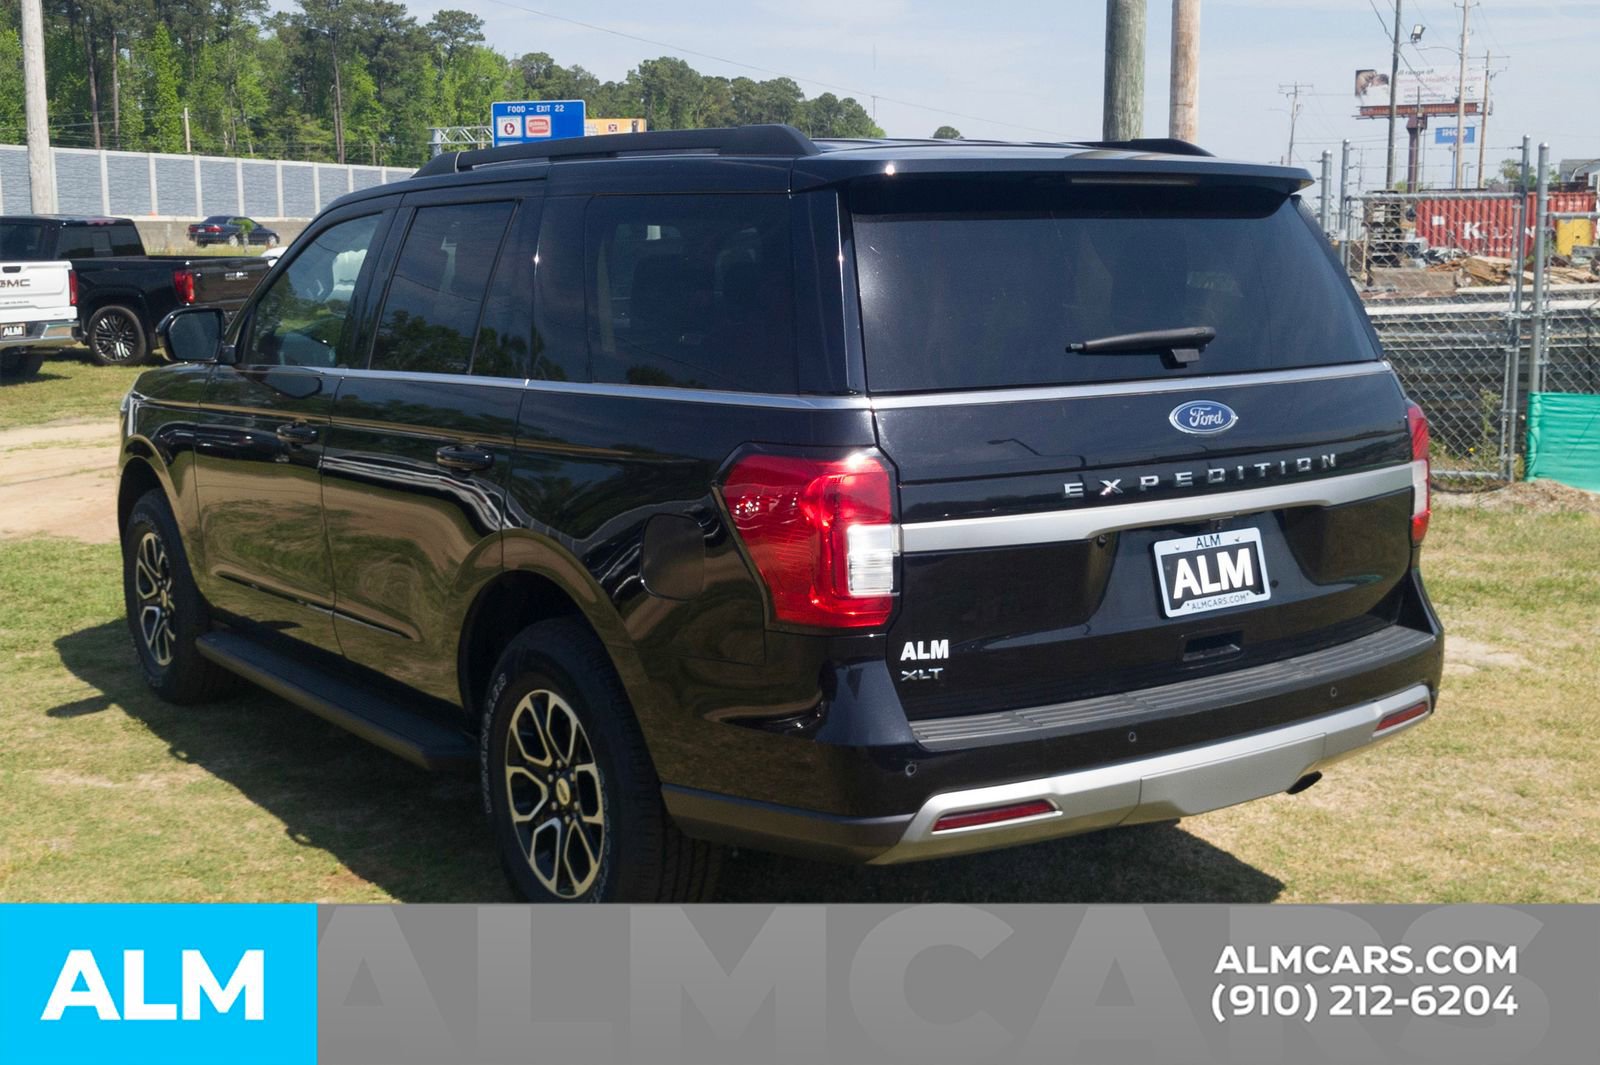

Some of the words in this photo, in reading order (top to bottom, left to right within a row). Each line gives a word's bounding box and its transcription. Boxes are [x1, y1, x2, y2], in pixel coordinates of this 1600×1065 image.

[507, 105, 526, 113] FOOD
[554, 104, 565, 112] 22
[3, 326, 23, 337] ALM
[1189, 406, 1224, 427] Ford
[1063, 453, 1337, 499] EXPEDITION
[1195, 534, 1221, 549] ALM
[1173, 548, 1254, 600] ALM
[1191, 593, 1247, 610] ALMCARS.COM
[900, 639, 949, 661] ALM
[901, 667, 944, 681] XLT
